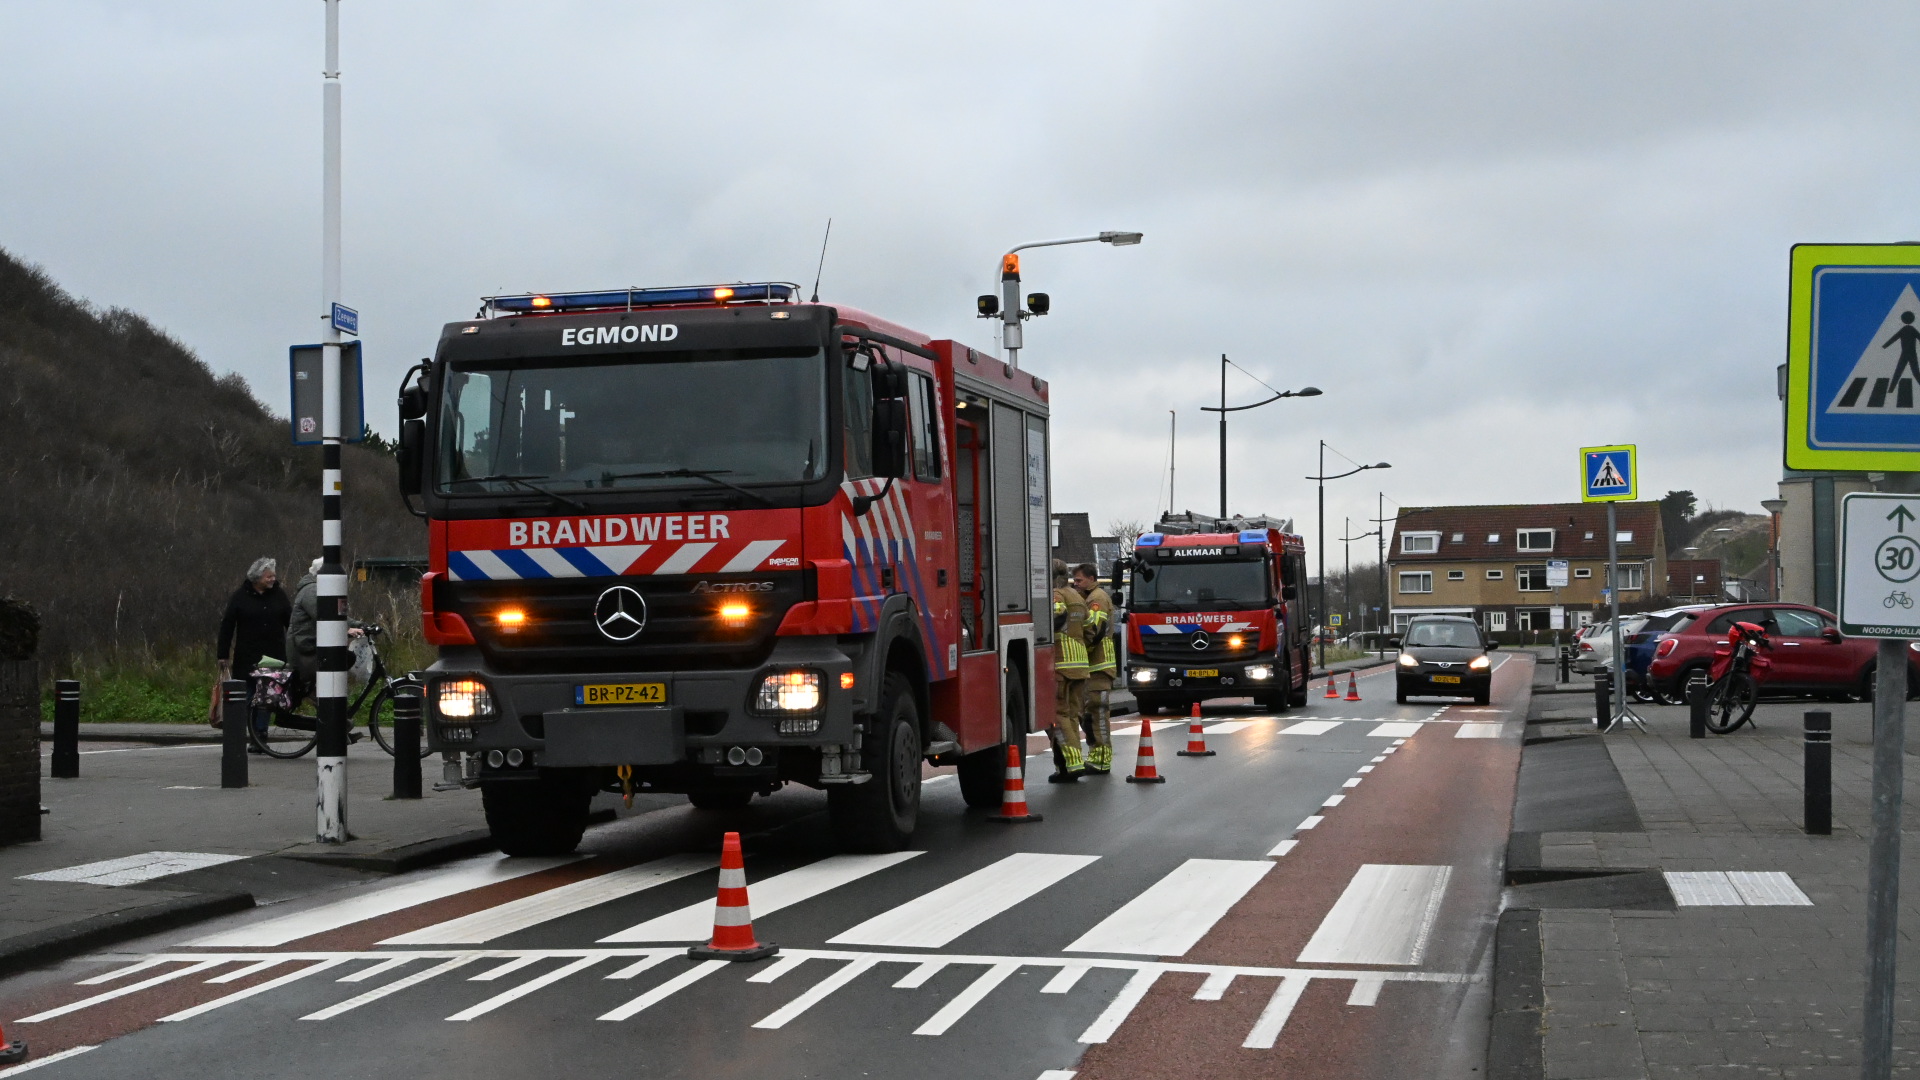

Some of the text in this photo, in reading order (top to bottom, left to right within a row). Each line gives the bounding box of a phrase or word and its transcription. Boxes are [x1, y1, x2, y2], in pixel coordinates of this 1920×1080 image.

[337, 309, 356, 329] Zeeweg
[561, 323, 678, 346] EGMOND
[509, 514, 731, 547] BRANDWEER
[1174, 549, 1222, 557] ALKMAAR
[1881, 546, 1914, 570] 30
[1165, 614, 1234, 624] BRANDWEER
[589, 685, 659, 701] BR-PZ-42
